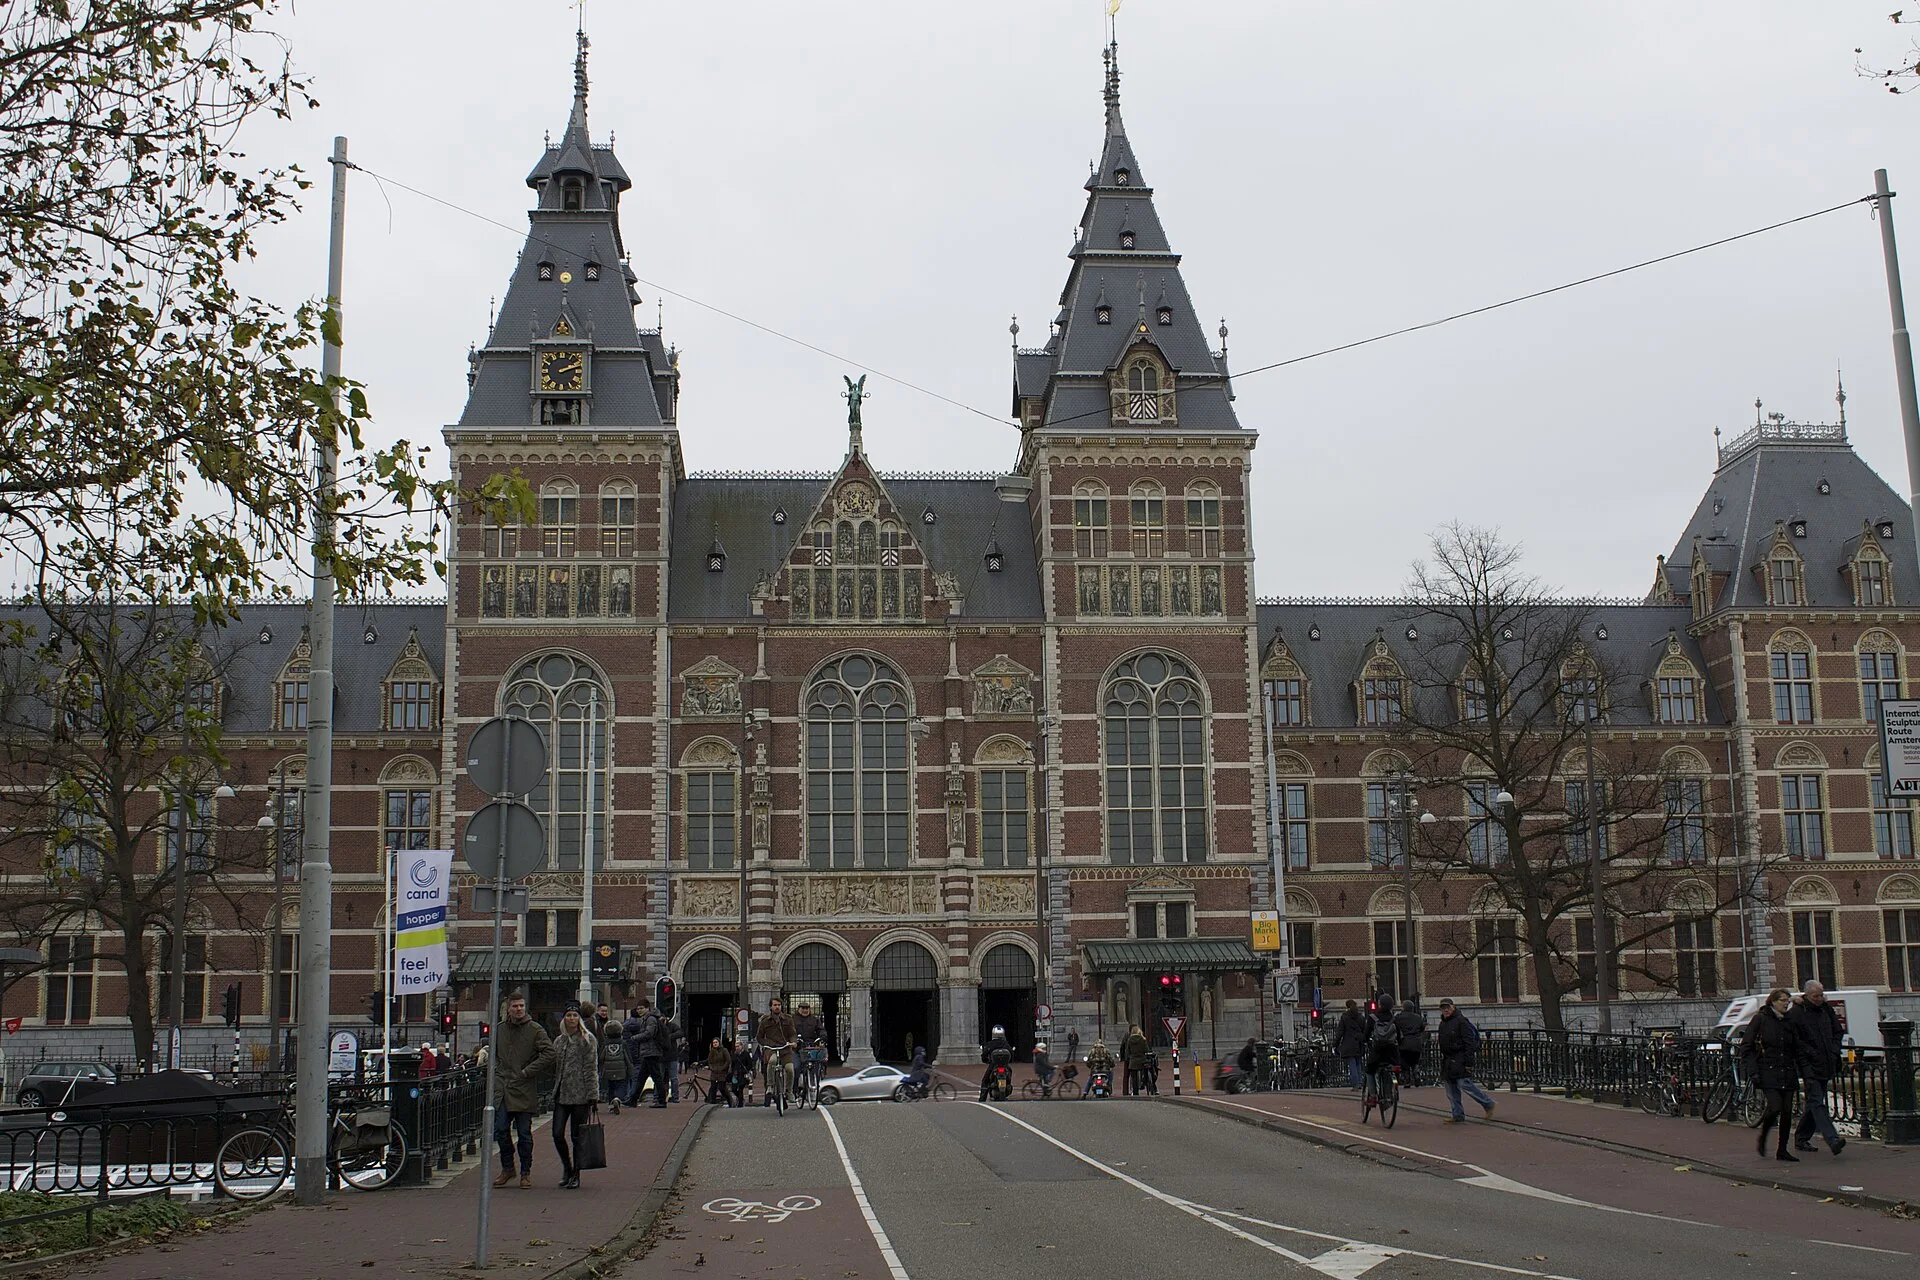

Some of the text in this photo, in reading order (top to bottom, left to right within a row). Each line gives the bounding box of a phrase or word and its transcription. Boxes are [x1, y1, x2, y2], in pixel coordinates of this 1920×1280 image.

[1885, 710, 1920, 718] Internat
[1893, 779, 1920, 791] ART
[406, 888, 440, 900] canal
[406, 911, 440, 925] hopper
[400, 957, 428, 971] feel
[401, 971, 443, 985] the city
